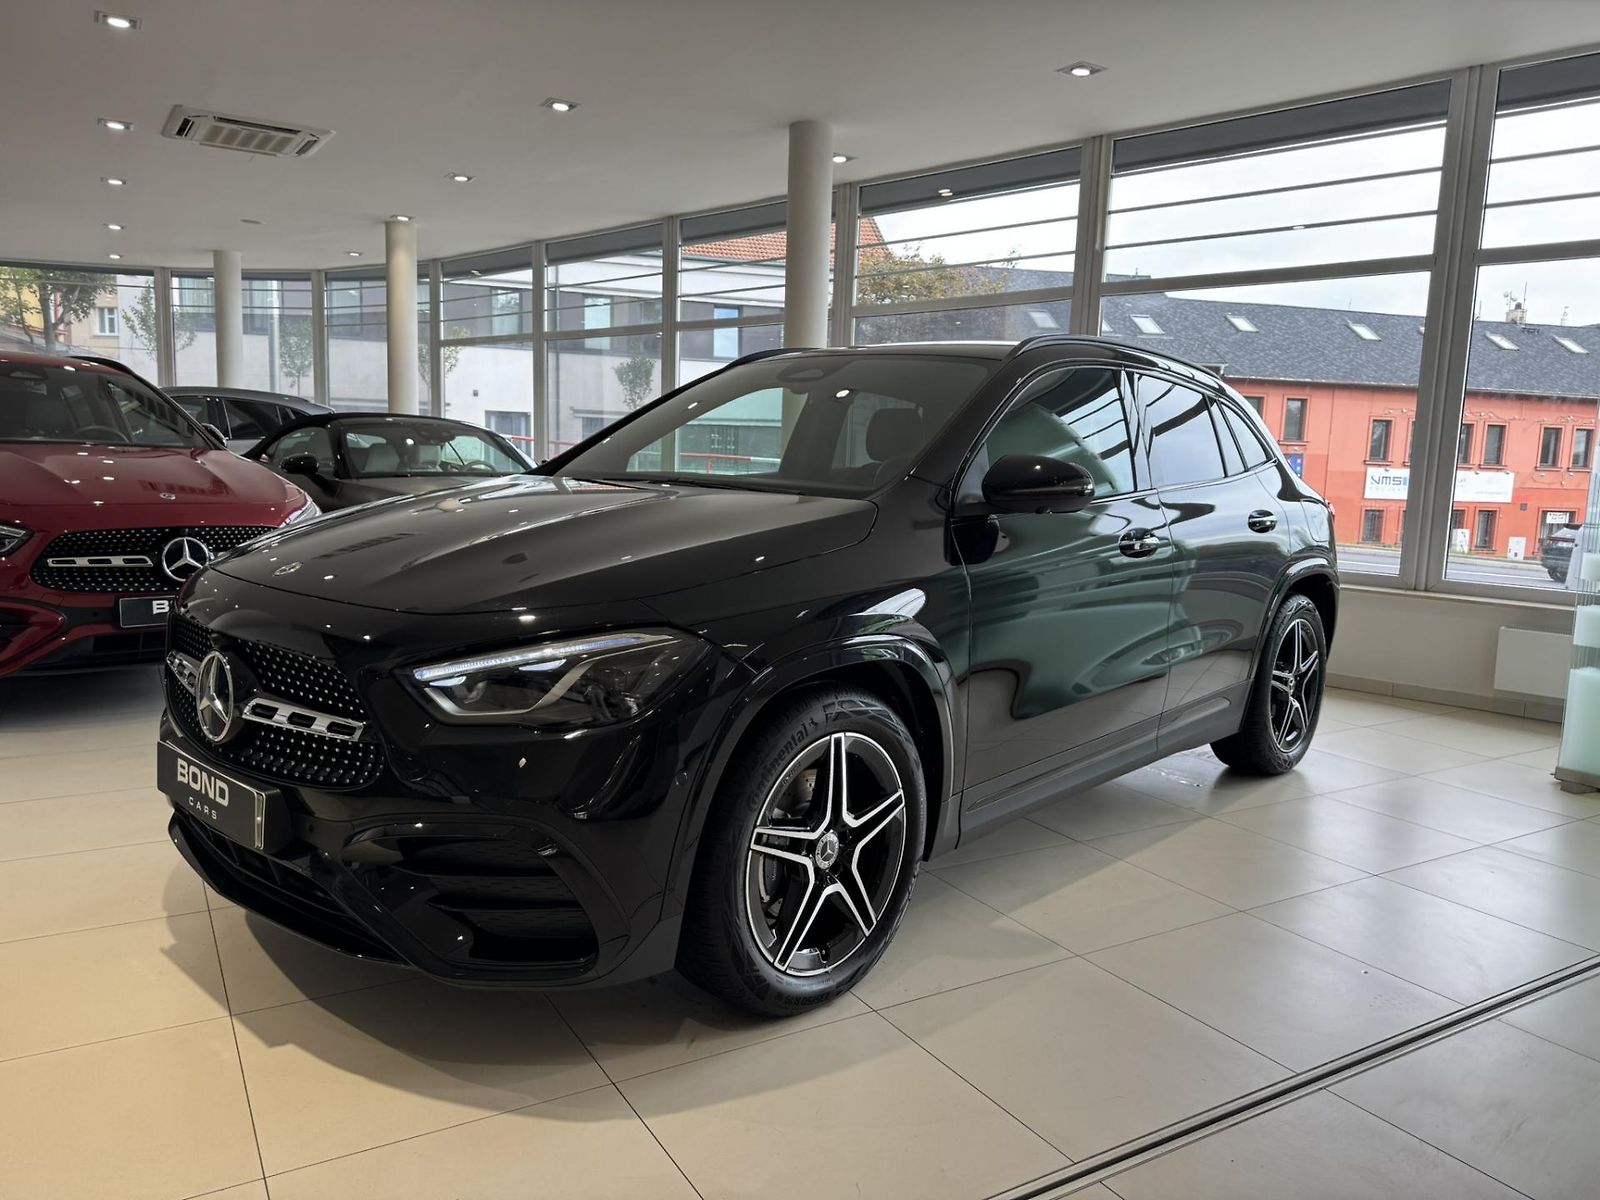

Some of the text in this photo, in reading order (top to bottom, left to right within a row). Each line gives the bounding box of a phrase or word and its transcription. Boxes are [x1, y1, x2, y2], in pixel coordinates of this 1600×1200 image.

[152, 599, 171, 615] B
[177, 757, 229, 807] BOND
[749, 722, 809, 812] Continental
[188, 796, 217, 820] CARS
